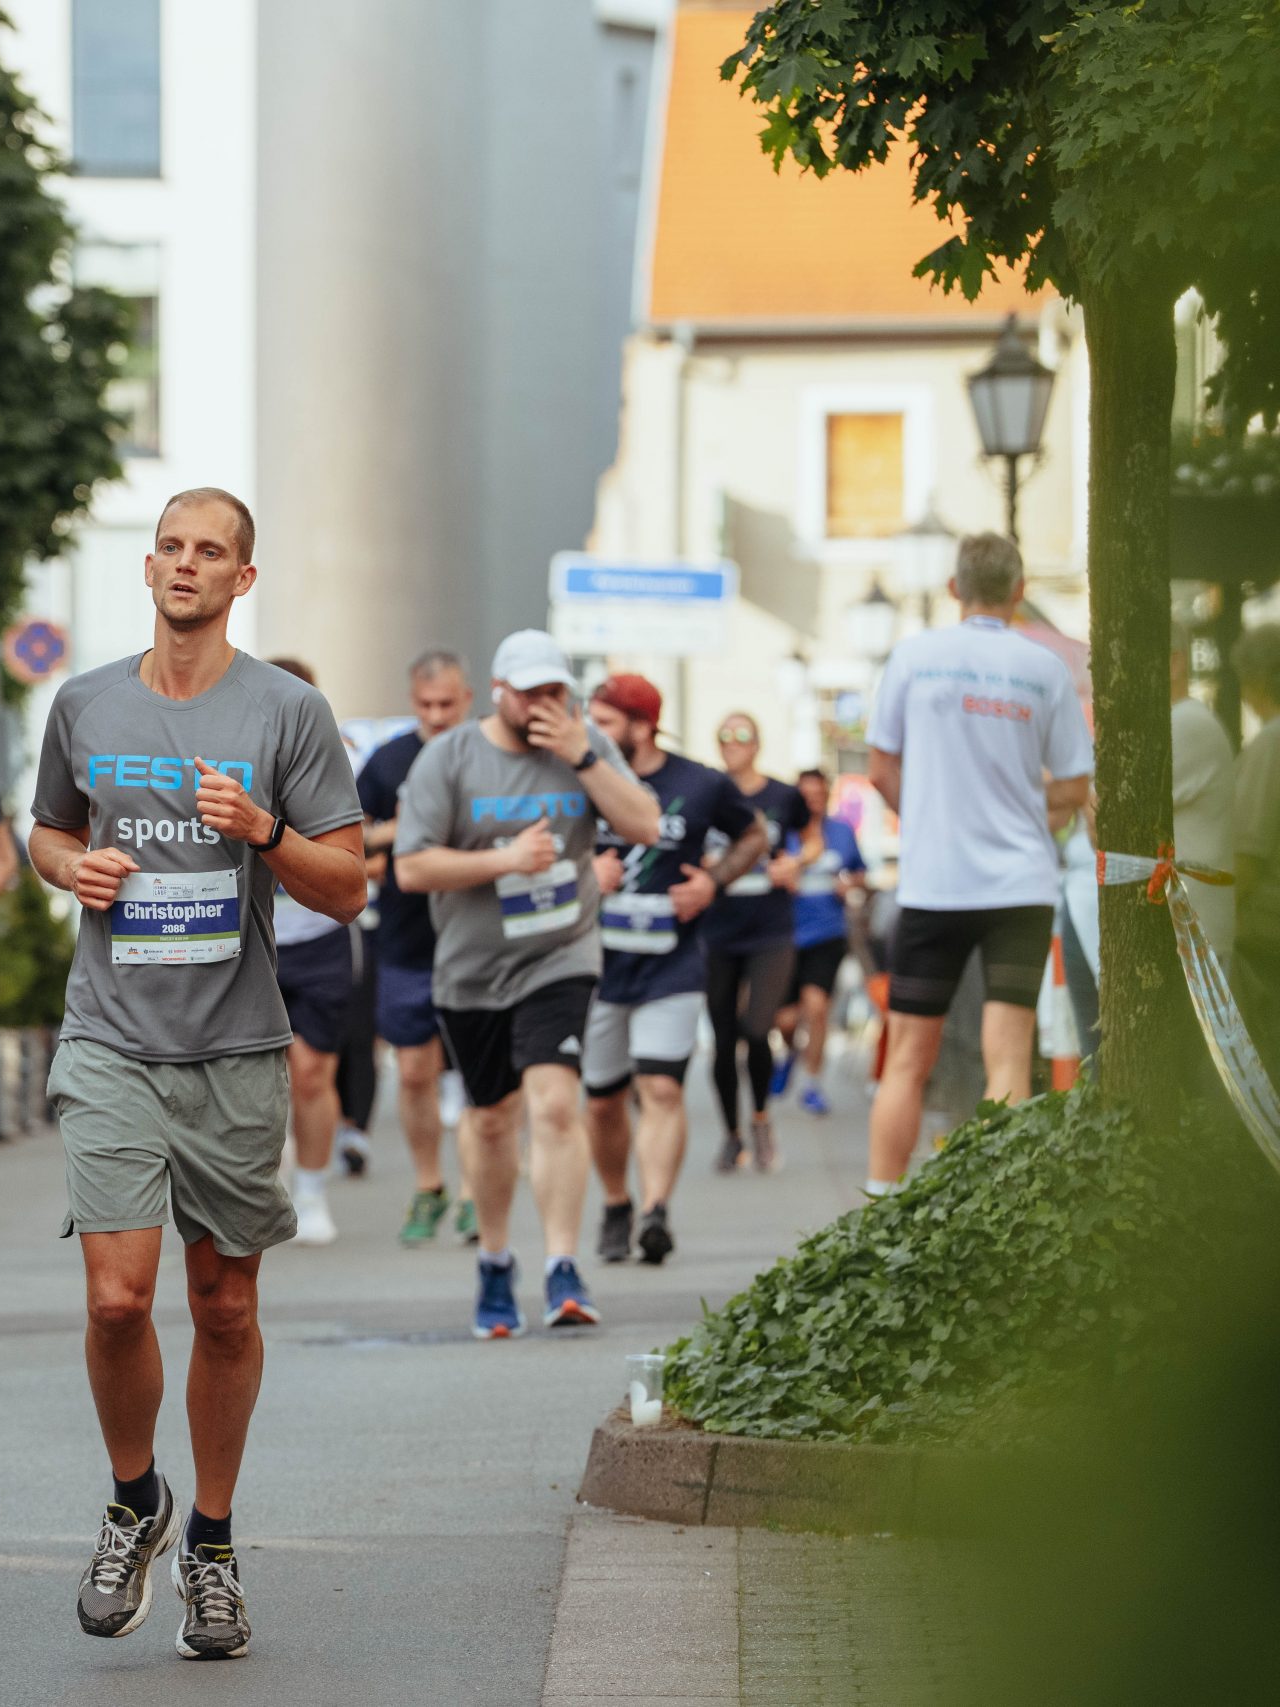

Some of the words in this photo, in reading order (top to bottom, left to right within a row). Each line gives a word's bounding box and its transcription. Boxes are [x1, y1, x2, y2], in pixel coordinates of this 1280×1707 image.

[962, 693, 1032, 722] BOSCH
[88, 755, 253, 792] FESTO
[472, 792, 587, 822] FESTO
[117, 817, 221, 848] sports
[123, 902, 224, 922] Christopher
[162, 923, 186, 934] 2088
